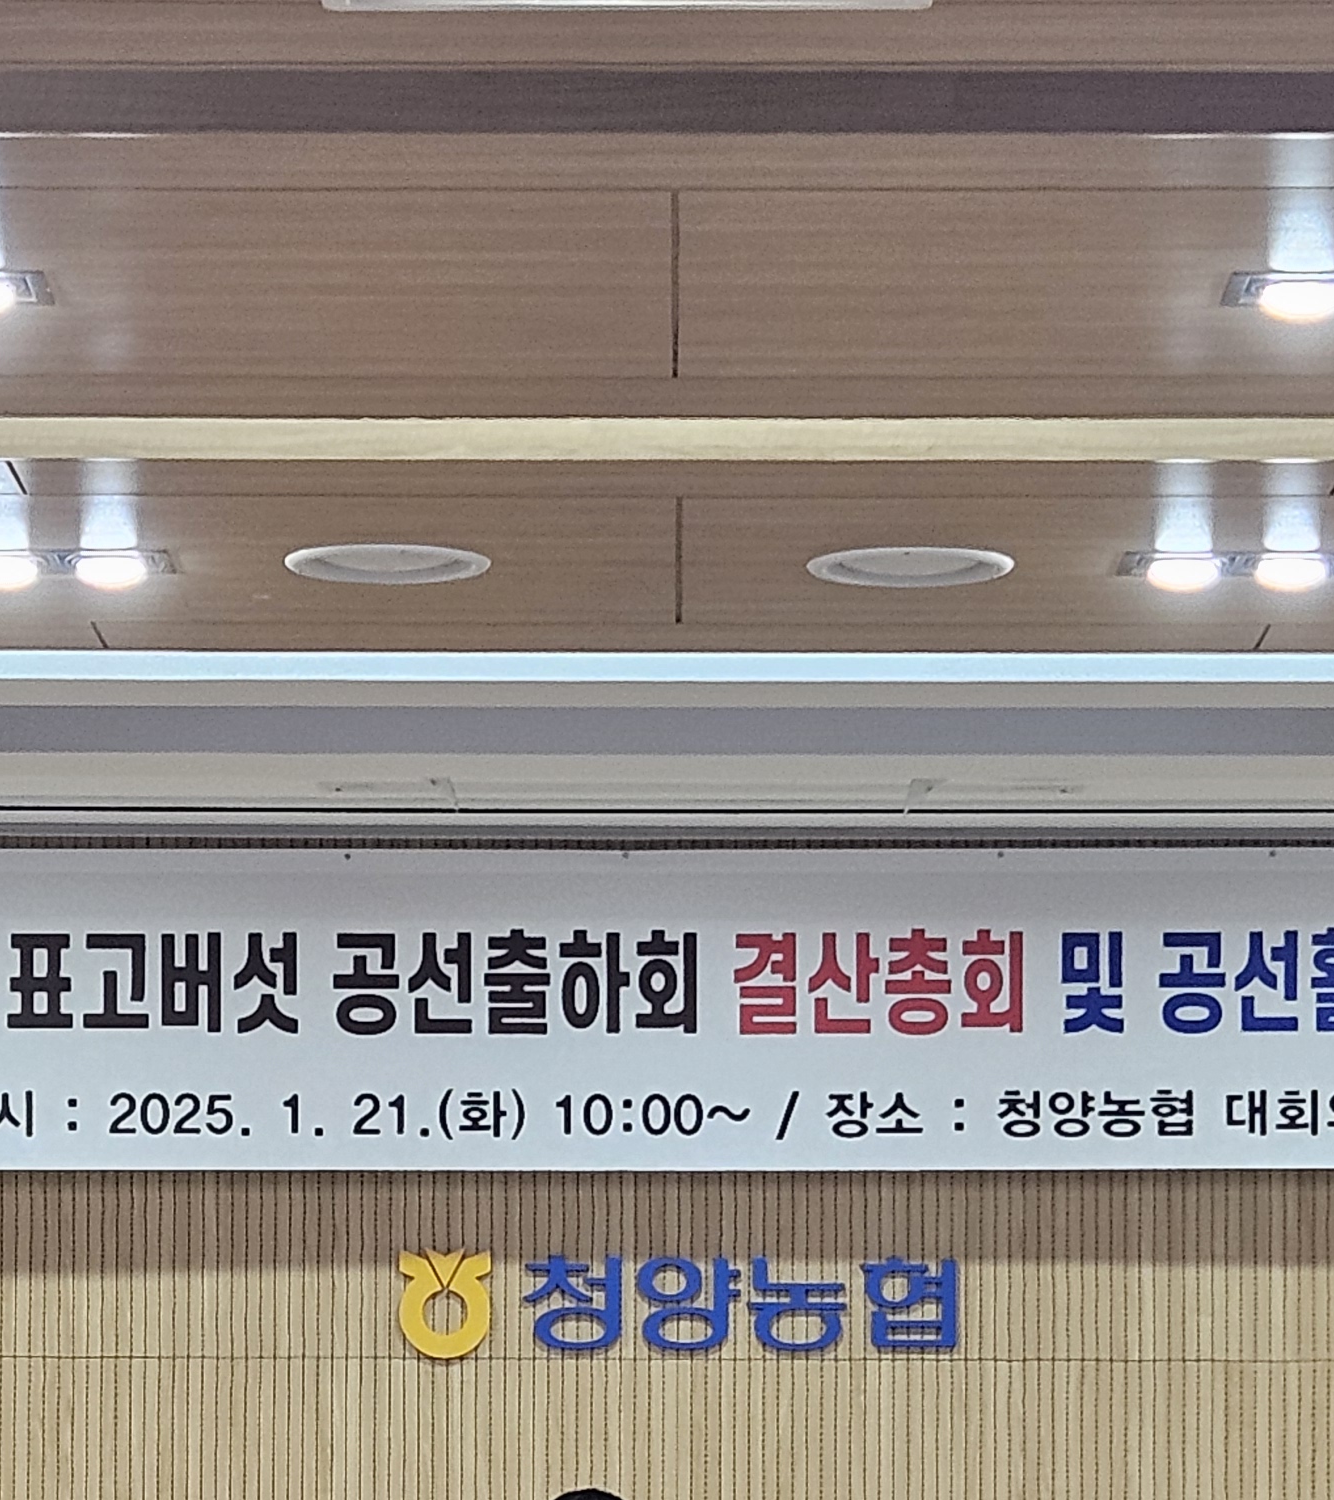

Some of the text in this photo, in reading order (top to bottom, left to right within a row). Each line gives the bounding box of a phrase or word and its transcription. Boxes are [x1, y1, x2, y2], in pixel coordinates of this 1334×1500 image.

[6, 931, 300, 1035] 표고버섯
[332, 928, 699, 1036] 공선출하회
[732, 928, 1025, 1036] 결산총회
[1060, 930, 1126, 1034] 및
[66, 1098, 78, 1132] :
[107, 1092, 252, 1137] 2025.
[281, 1093, 325, 1137] 1.
[352, 1088, 527, 1141] 21.(화)
[555, 1092, 752, 1137] 10:00~
[775, 1090, 800, 1141] /
[824, 1090, 925, 1139] 장소
[953, 1098, 966, 1132] :
[996, 1089, 1195, 1139] 청양농협
[523, 1254, 960, 1352] 청양농협
